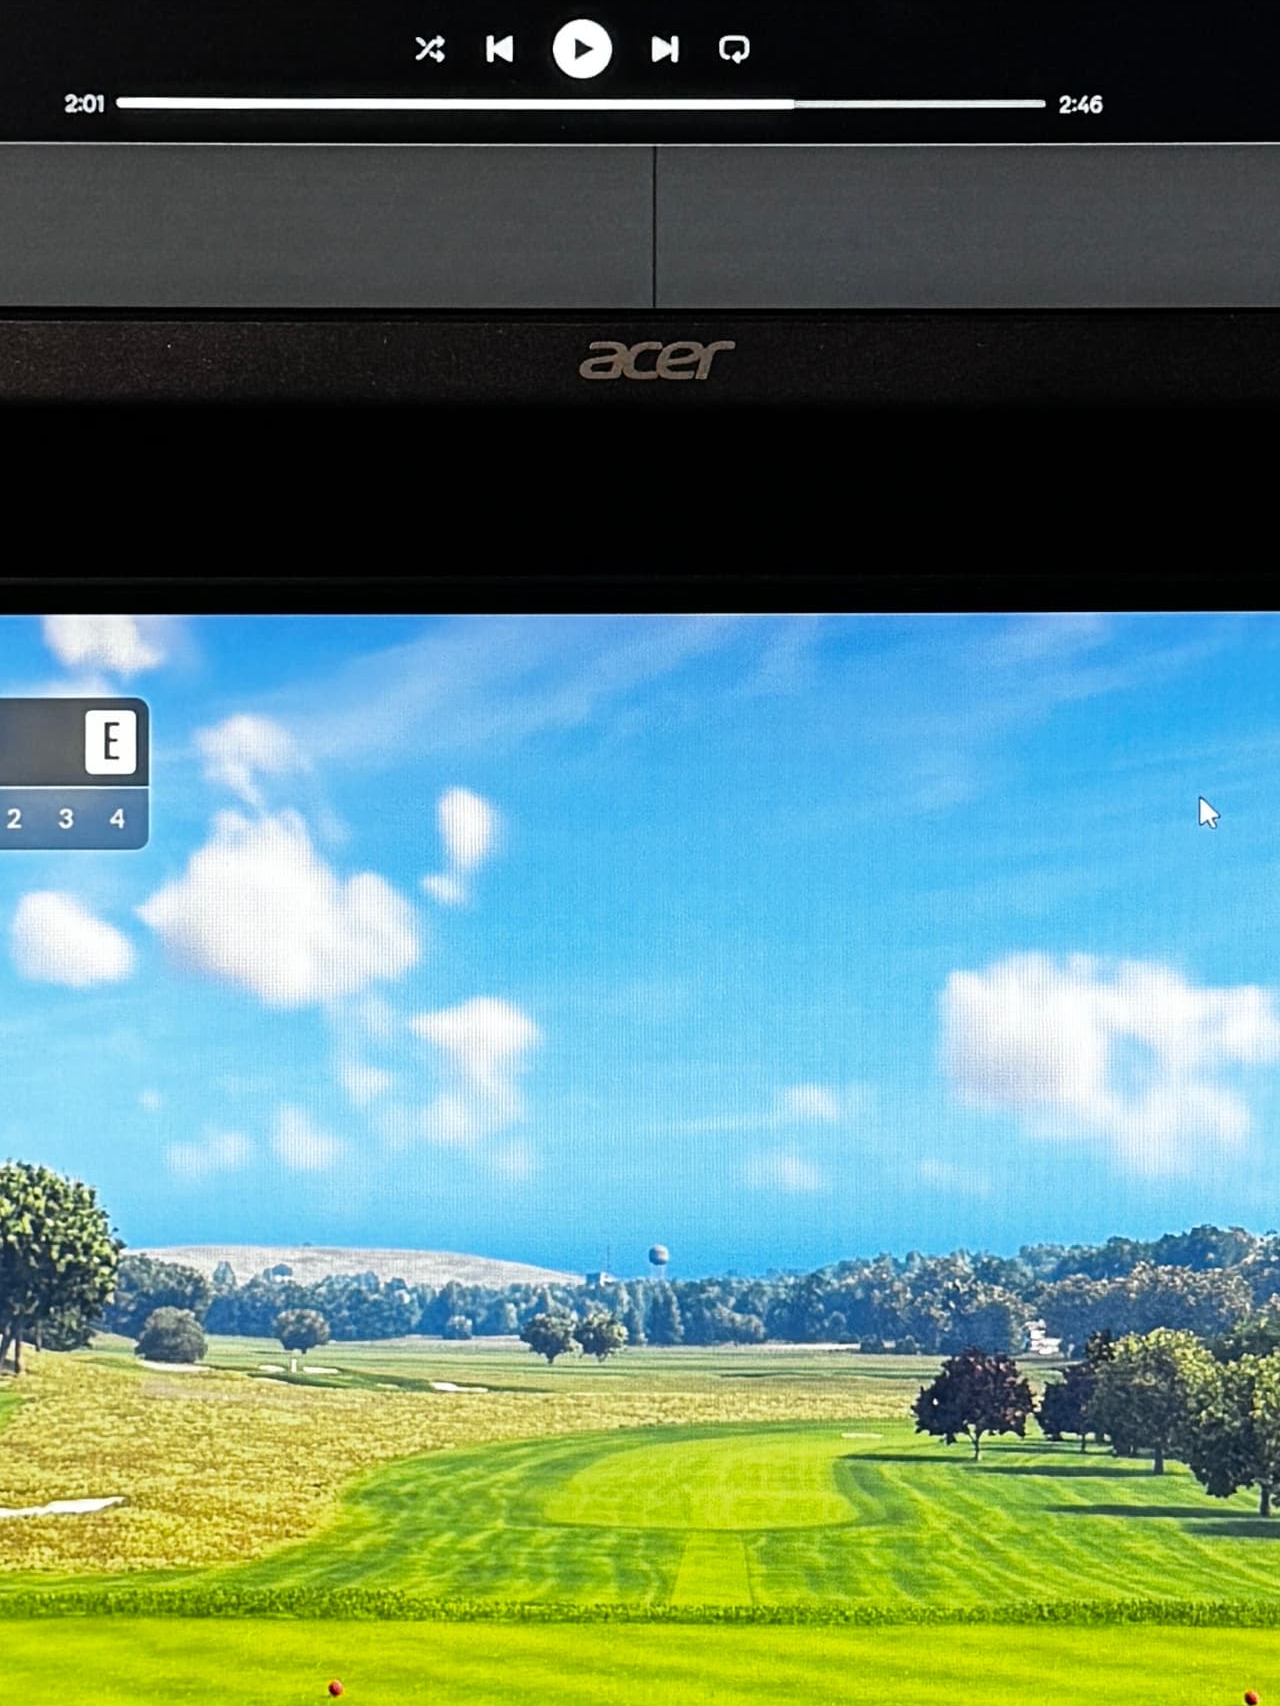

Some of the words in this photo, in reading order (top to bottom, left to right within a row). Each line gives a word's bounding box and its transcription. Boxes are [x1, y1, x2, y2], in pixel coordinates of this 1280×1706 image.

[65, 94, 105, 114] 2:01
[1058, 93, 1103, 114] 2:46
[578, 340, 737, 381] acer
[105, 721, 120, 760] E
[7, 808, 22, 830] 2
[59, 808, 74, 830] 3
[110, 808, 125, 830] 4
